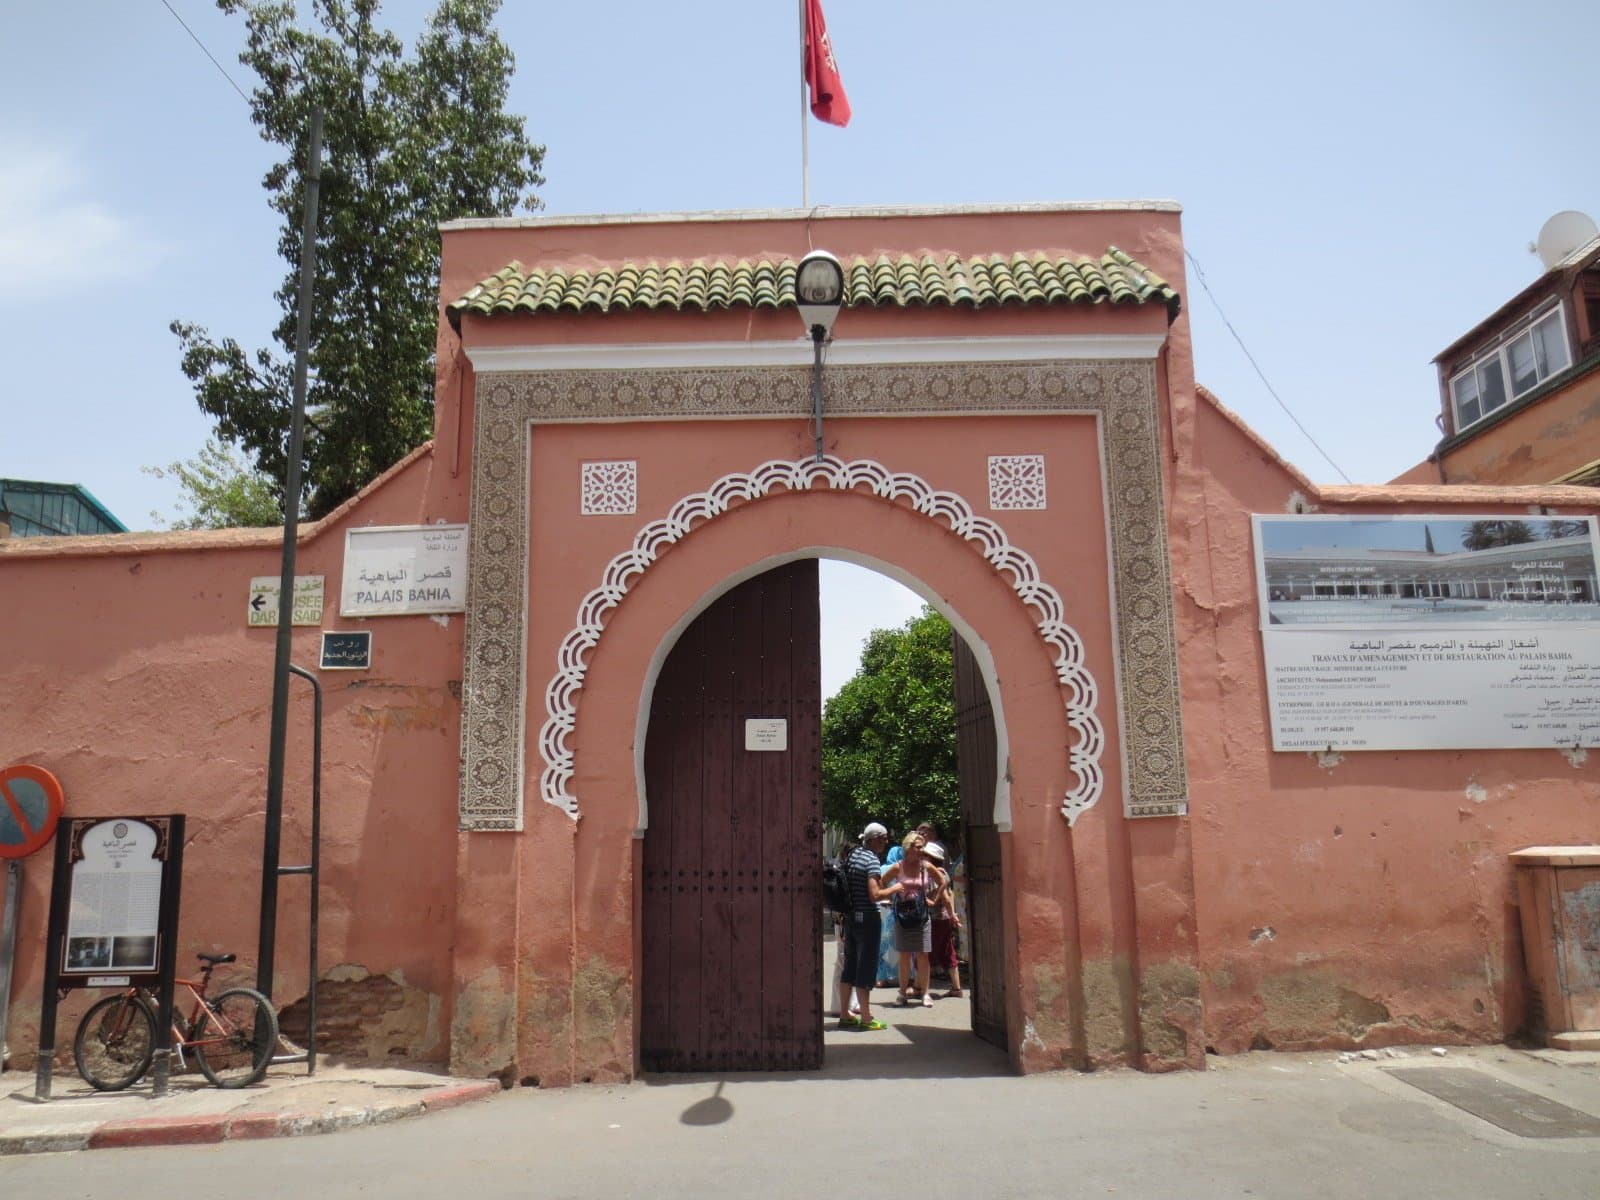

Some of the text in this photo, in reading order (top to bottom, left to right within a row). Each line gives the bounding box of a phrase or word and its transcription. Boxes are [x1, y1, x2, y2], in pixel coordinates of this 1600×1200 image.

[359, 566, 452, 585] قصر الباهية
[294, 595, 322, 609] SEE
[356, 587, 452, 604] PALAIS BAHIA
[251, 609, 322, 624] DAR SAID
[1312, 654, 1349, 663] TRAVAUX
[1519, 652, 1547, 661] PALAIS
[1548, 652, 1573, 660] BAHIA
